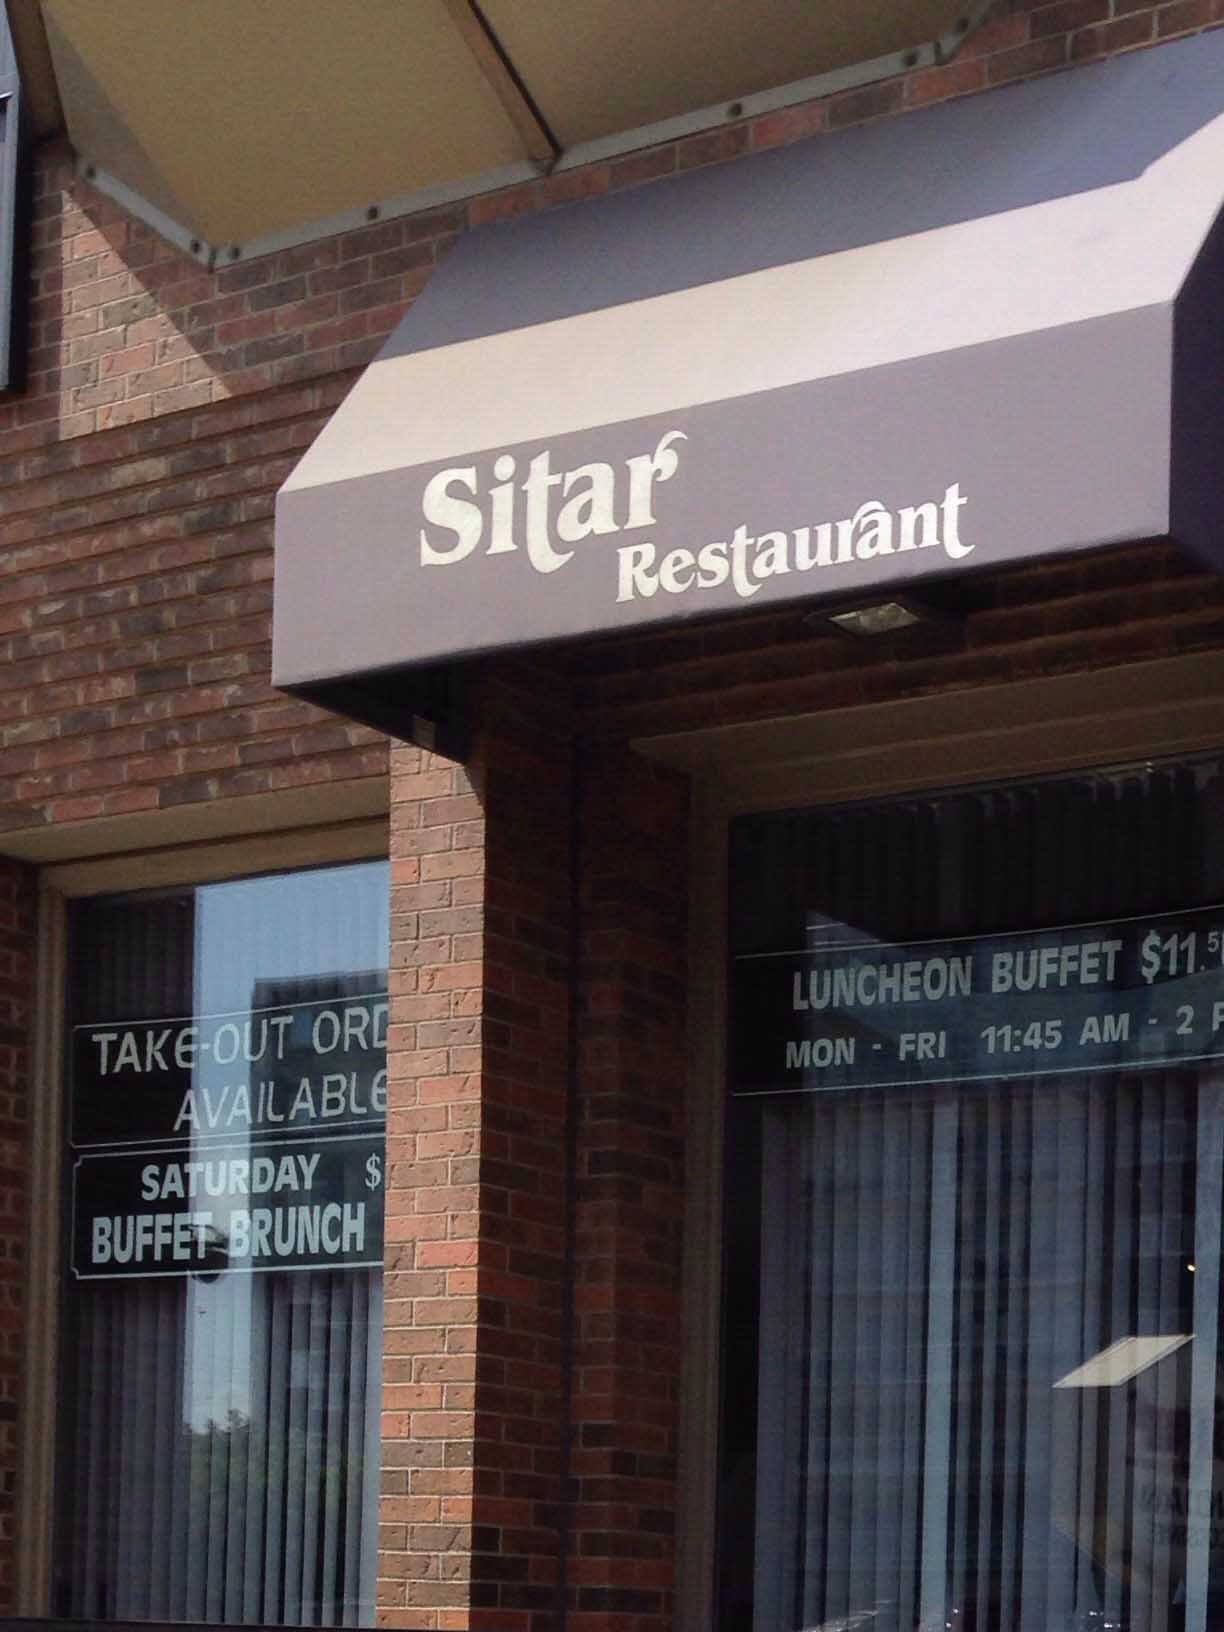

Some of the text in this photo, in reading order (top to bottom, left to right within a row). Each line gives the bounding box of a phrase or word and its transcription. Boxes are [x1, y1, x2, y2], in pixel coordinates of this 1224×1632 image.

[419, 430, 689, 574] Sitar
[615, 482, 976, 603] Restaurant
[792, 956, 973, 1011] LUNCHEON
[991, 940, 1124, 994] BUFFET
[786, 1037, 856, 1070] MON
[898, 1031, 947, 1061] FRI
[980, 1019, 1063, 1054] 11:45
[1079, 1012, 1130, 1046] AM
[1175, 1004, 1195, 1035] 2
[173, 1067, 388, 1132] AVAILABLE
[140, 1153, 321, 1201] SATURDAY
[91, 1202, 366, 1264] BUFFET BRUNCH
